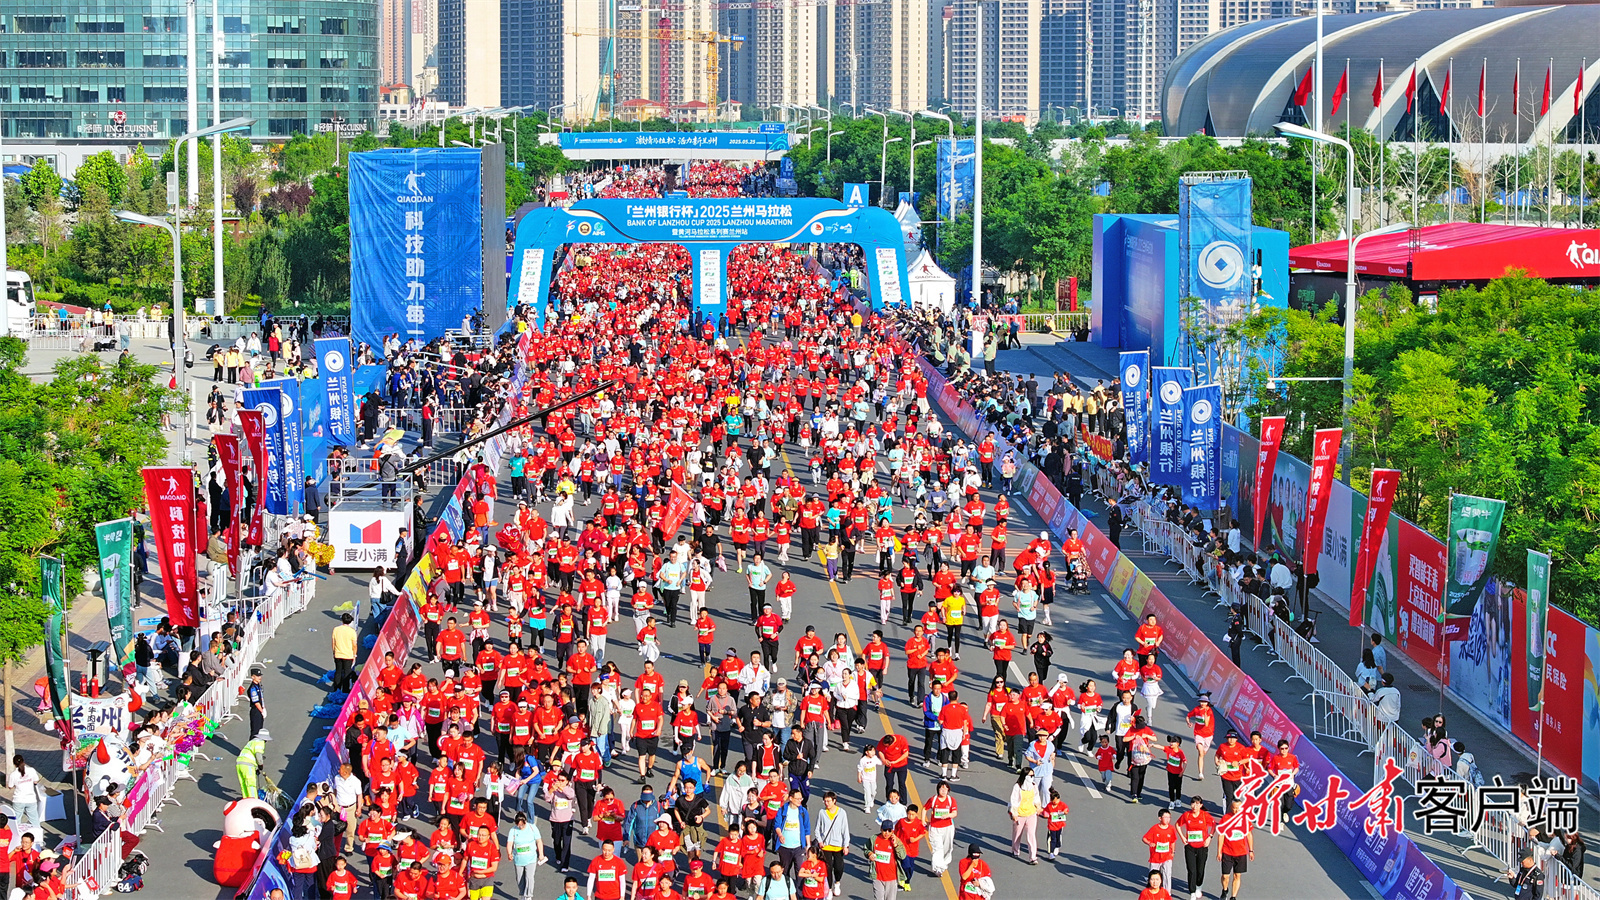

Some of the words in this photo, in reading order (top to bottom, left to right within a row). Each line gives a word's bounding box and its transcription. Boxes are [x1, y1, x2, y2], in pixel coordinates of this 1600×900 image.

[104, 124, 123, 132] JING
[124, 124, 158, 132] CUISINE
[849, 185, 863, 204] A
[627, 219, 646, 227] BANK
[722, 218, 754, 226] LANZHOU
[756, 218, 793, 226] MARATHON
[344, 548, 388, 562] 度小满
[1325, 526, 1347, 568] 度小满
[1408, 553, 1438, 592] 买智能手表
[1407, 581, 1440, 620] 上京东618
[86, 706, 96, 732] 牛肉面
[117, 882, 130, 893] 84
